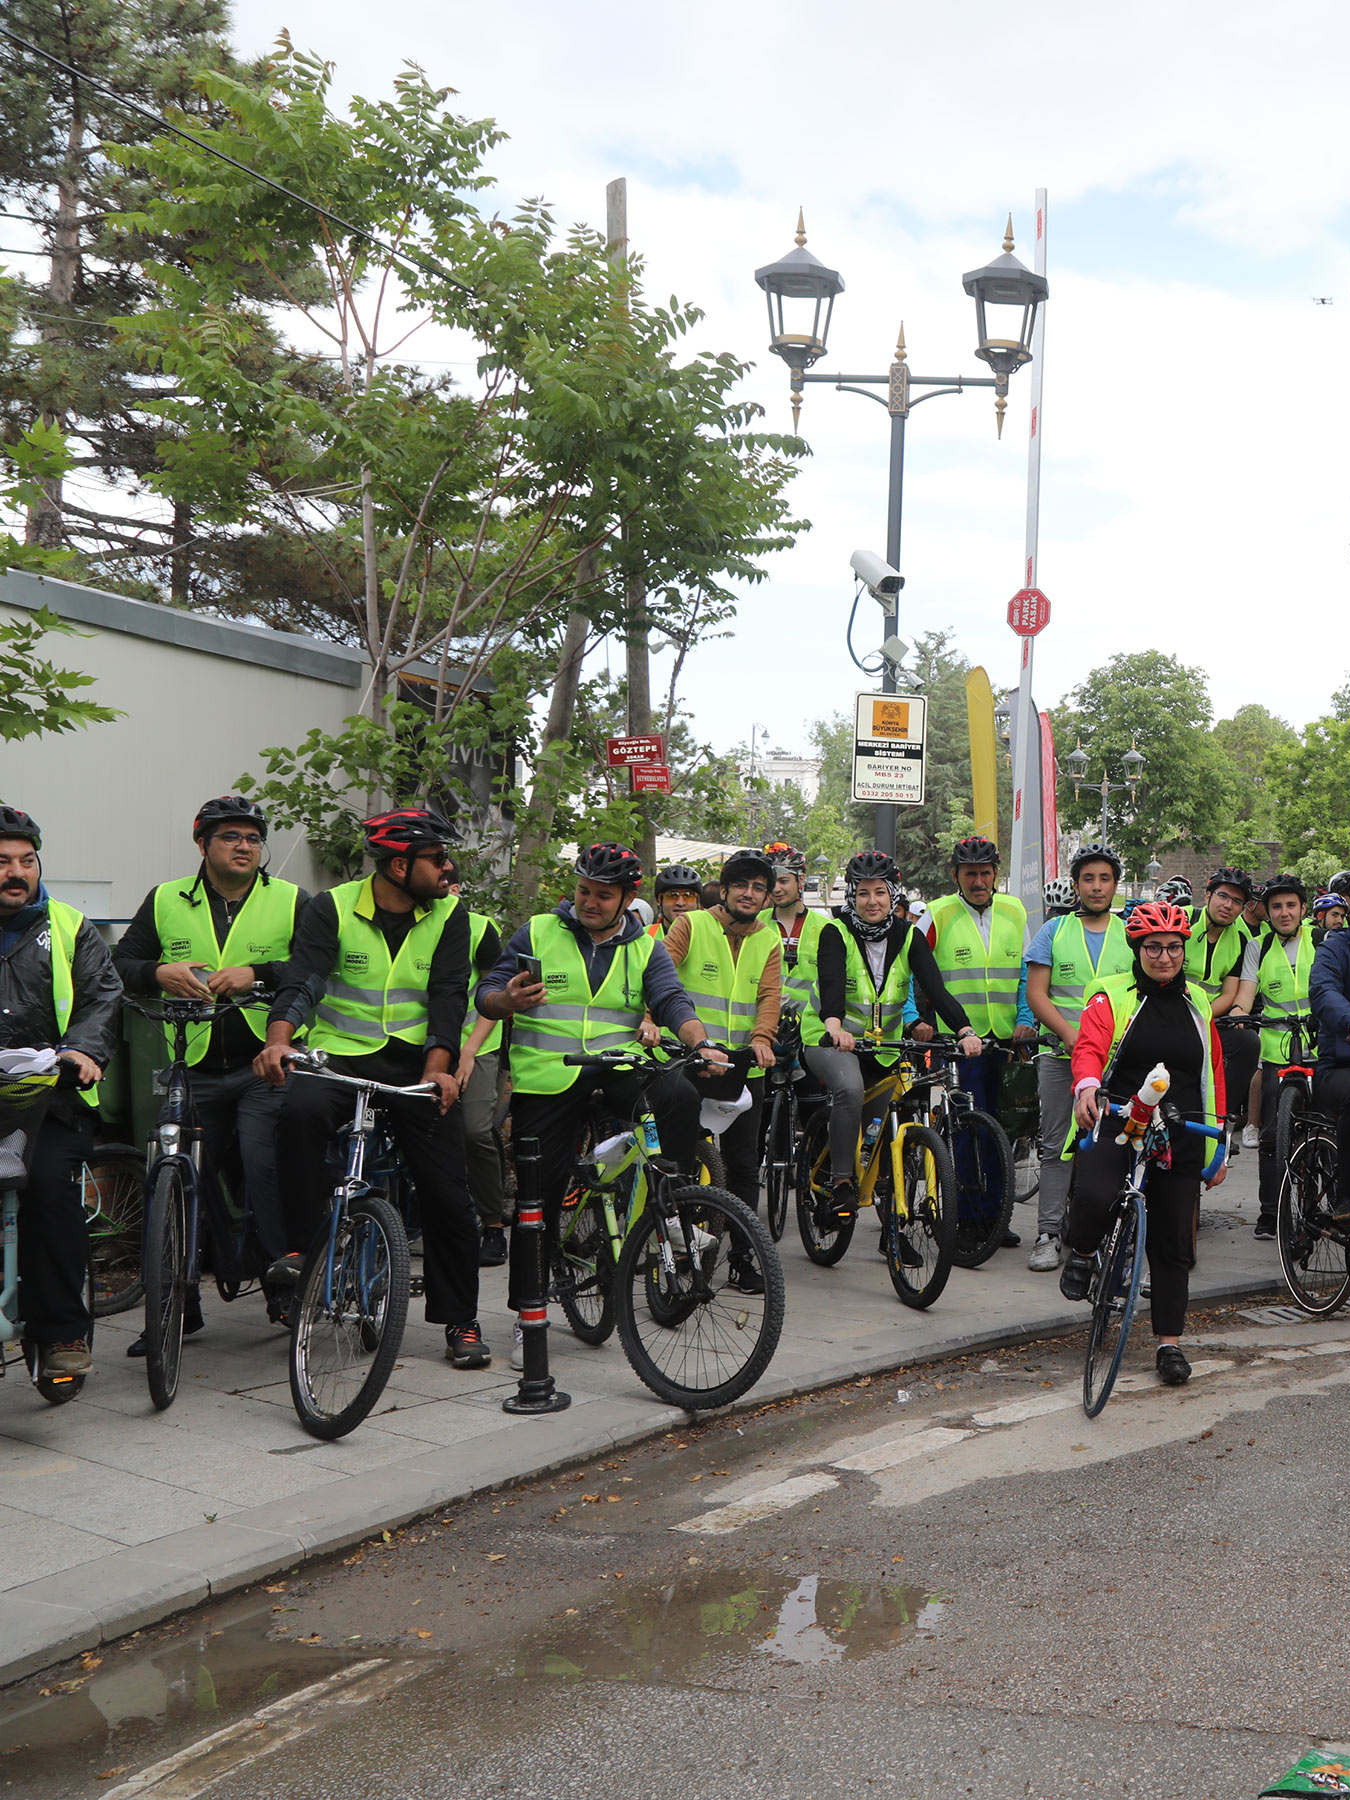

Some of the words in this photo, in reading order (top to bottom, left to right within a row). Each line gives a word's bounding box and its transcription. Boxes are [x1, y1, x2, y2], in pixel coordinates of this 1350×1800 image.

[1021, 599, 1030, 626] PARK
[1029, 595, 1038, 629] YASAK
[612, 744, 658, 755] GÖZTEPE
[890, 742, 921, 751] BARİYER
[874, 749, 905, 758] SİSTEMİ
[867, 763, 900, 771] BARİYER
[895, 782, 919, 790] İRTİBAT
[1108, 1217, 1122, 1257] SCOTT
